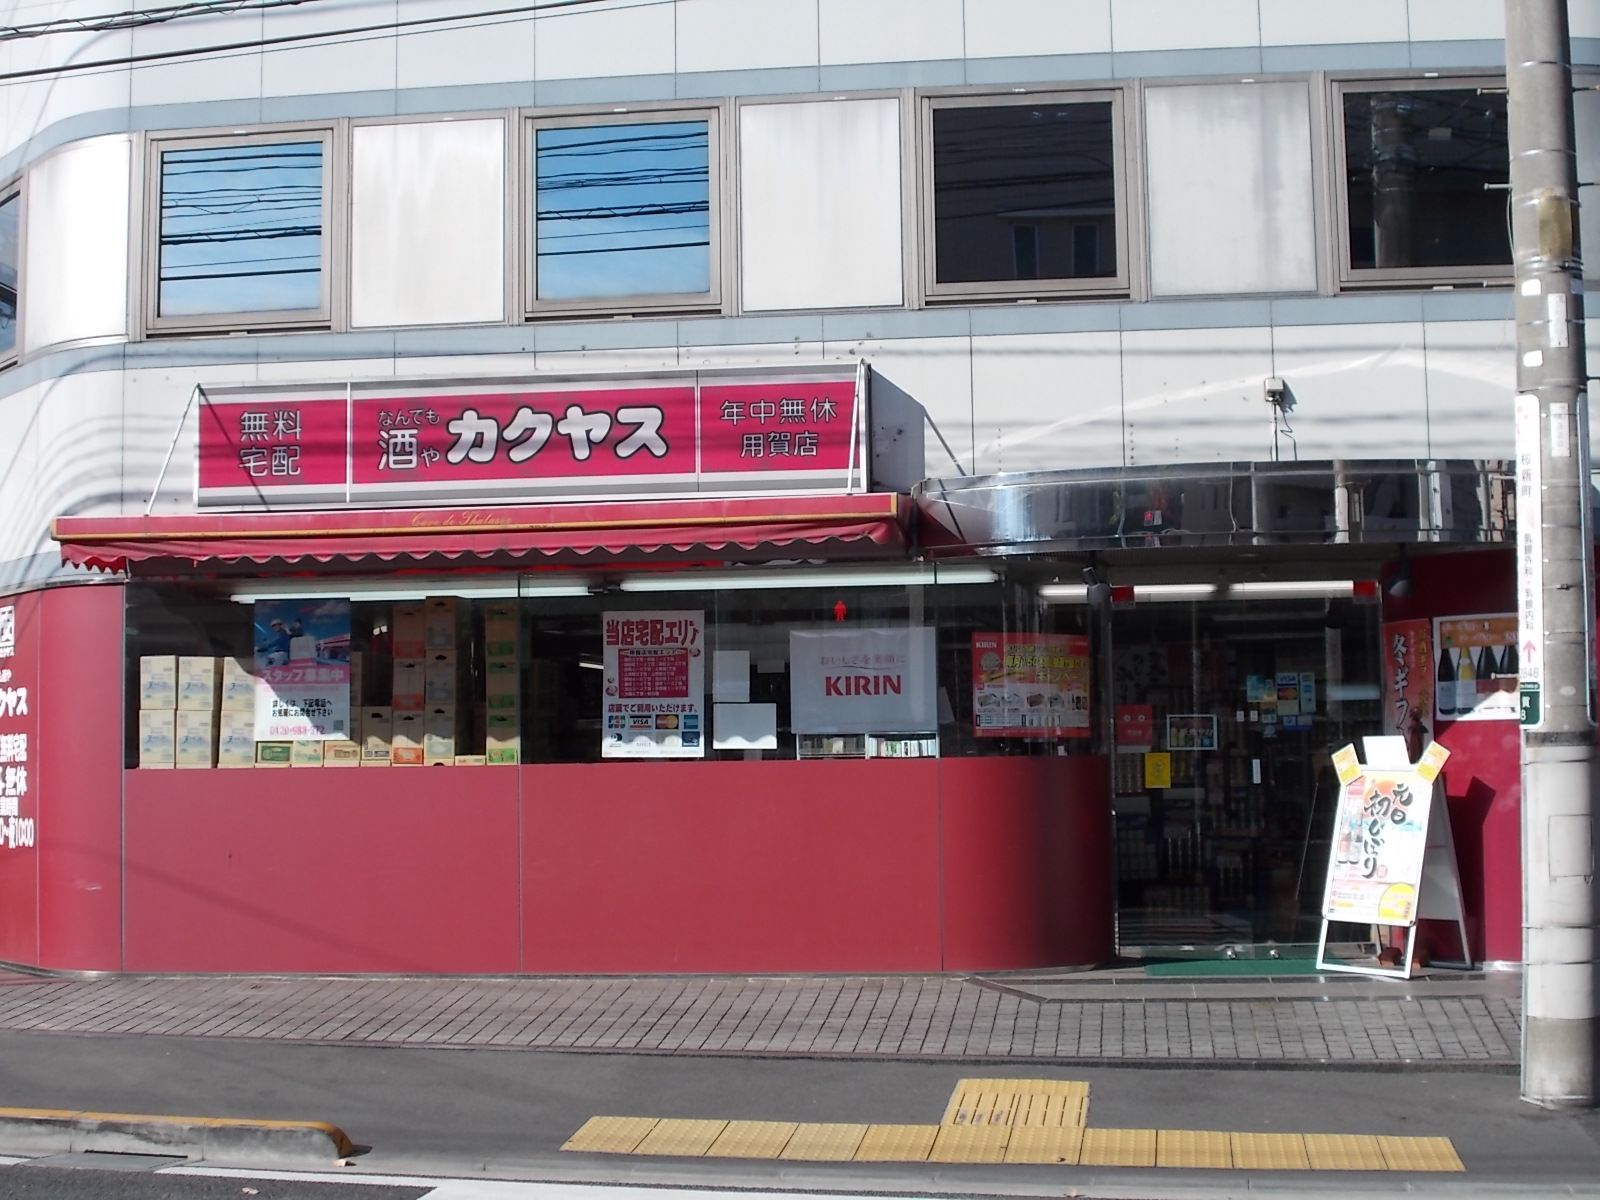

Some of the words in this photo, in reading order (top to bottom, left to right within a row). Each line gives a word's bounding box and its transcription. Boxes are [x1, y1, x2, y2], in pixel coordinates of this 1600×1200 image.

[239, 410, 302, 442] 無料
[378, 409, 440, 426] なんでも
[719, 396, 837, 425] 年中無休
[377, 429, 440, 472] 酒や
[446, 404, 669, 466] カクヤス
[740, 430, 820, 459] 用賀店
[238, 445, 302, 477] 宅配
[606, 618, 699, 646] 当店宅配エリア
[825, 675, 901, 696] KIRIN
[1393, 634, 1409, 737] 冬ギフ
[1390, 783, 1414, 825] 元日
